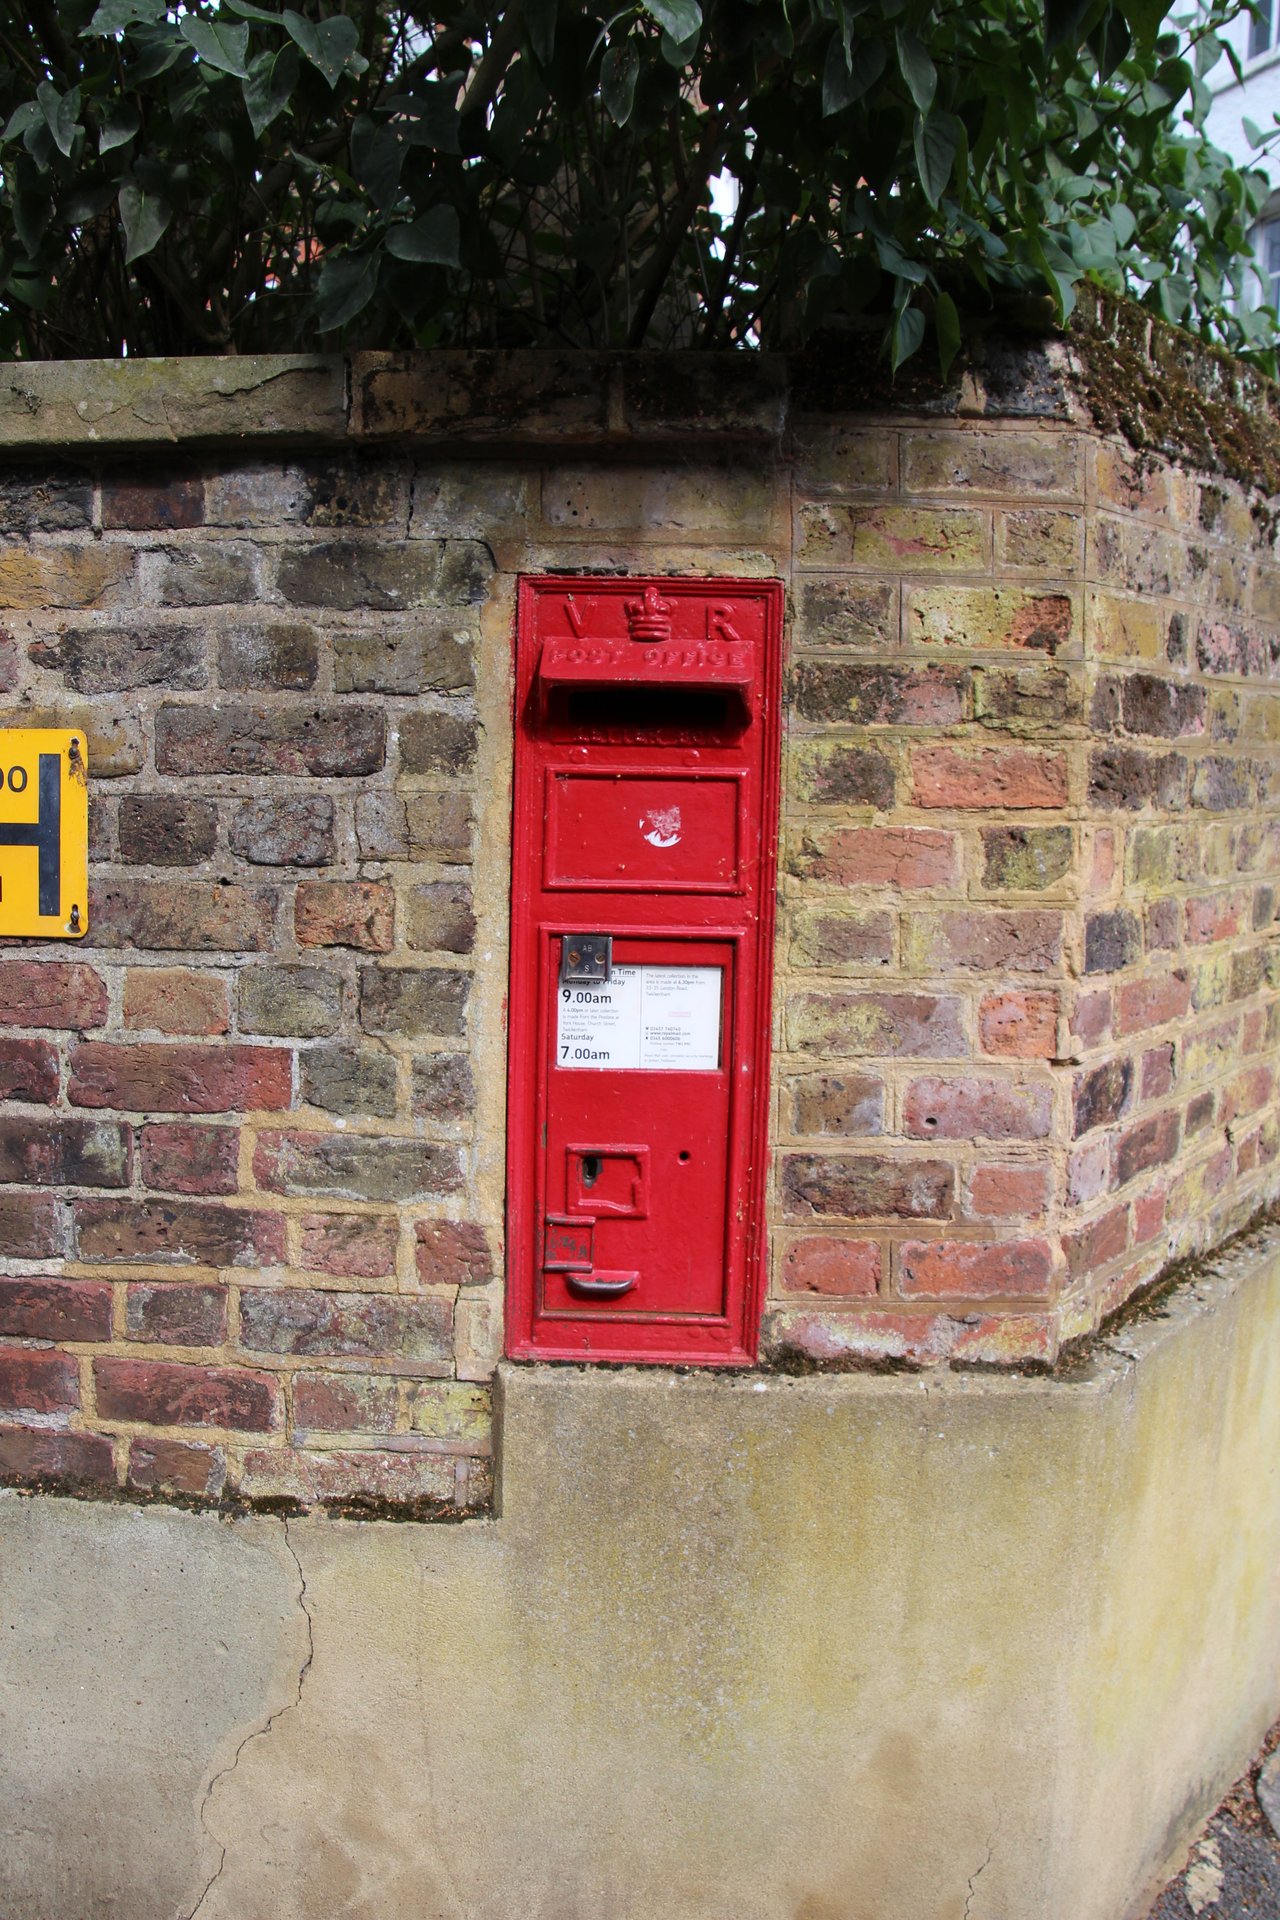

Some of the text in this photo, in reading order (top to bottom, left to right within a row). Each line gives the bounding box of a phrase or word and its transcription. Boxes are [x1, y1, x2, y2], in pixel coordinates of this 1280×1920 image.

[564, 601, 741, 641] V R
[550, 649, 746, 668] POST OFFICE
[562, 990, 612, 1003] 9.00am
[561, 1033, 594, 1041] Saturday
[560, 1046, 610, 1060] 7.00am
